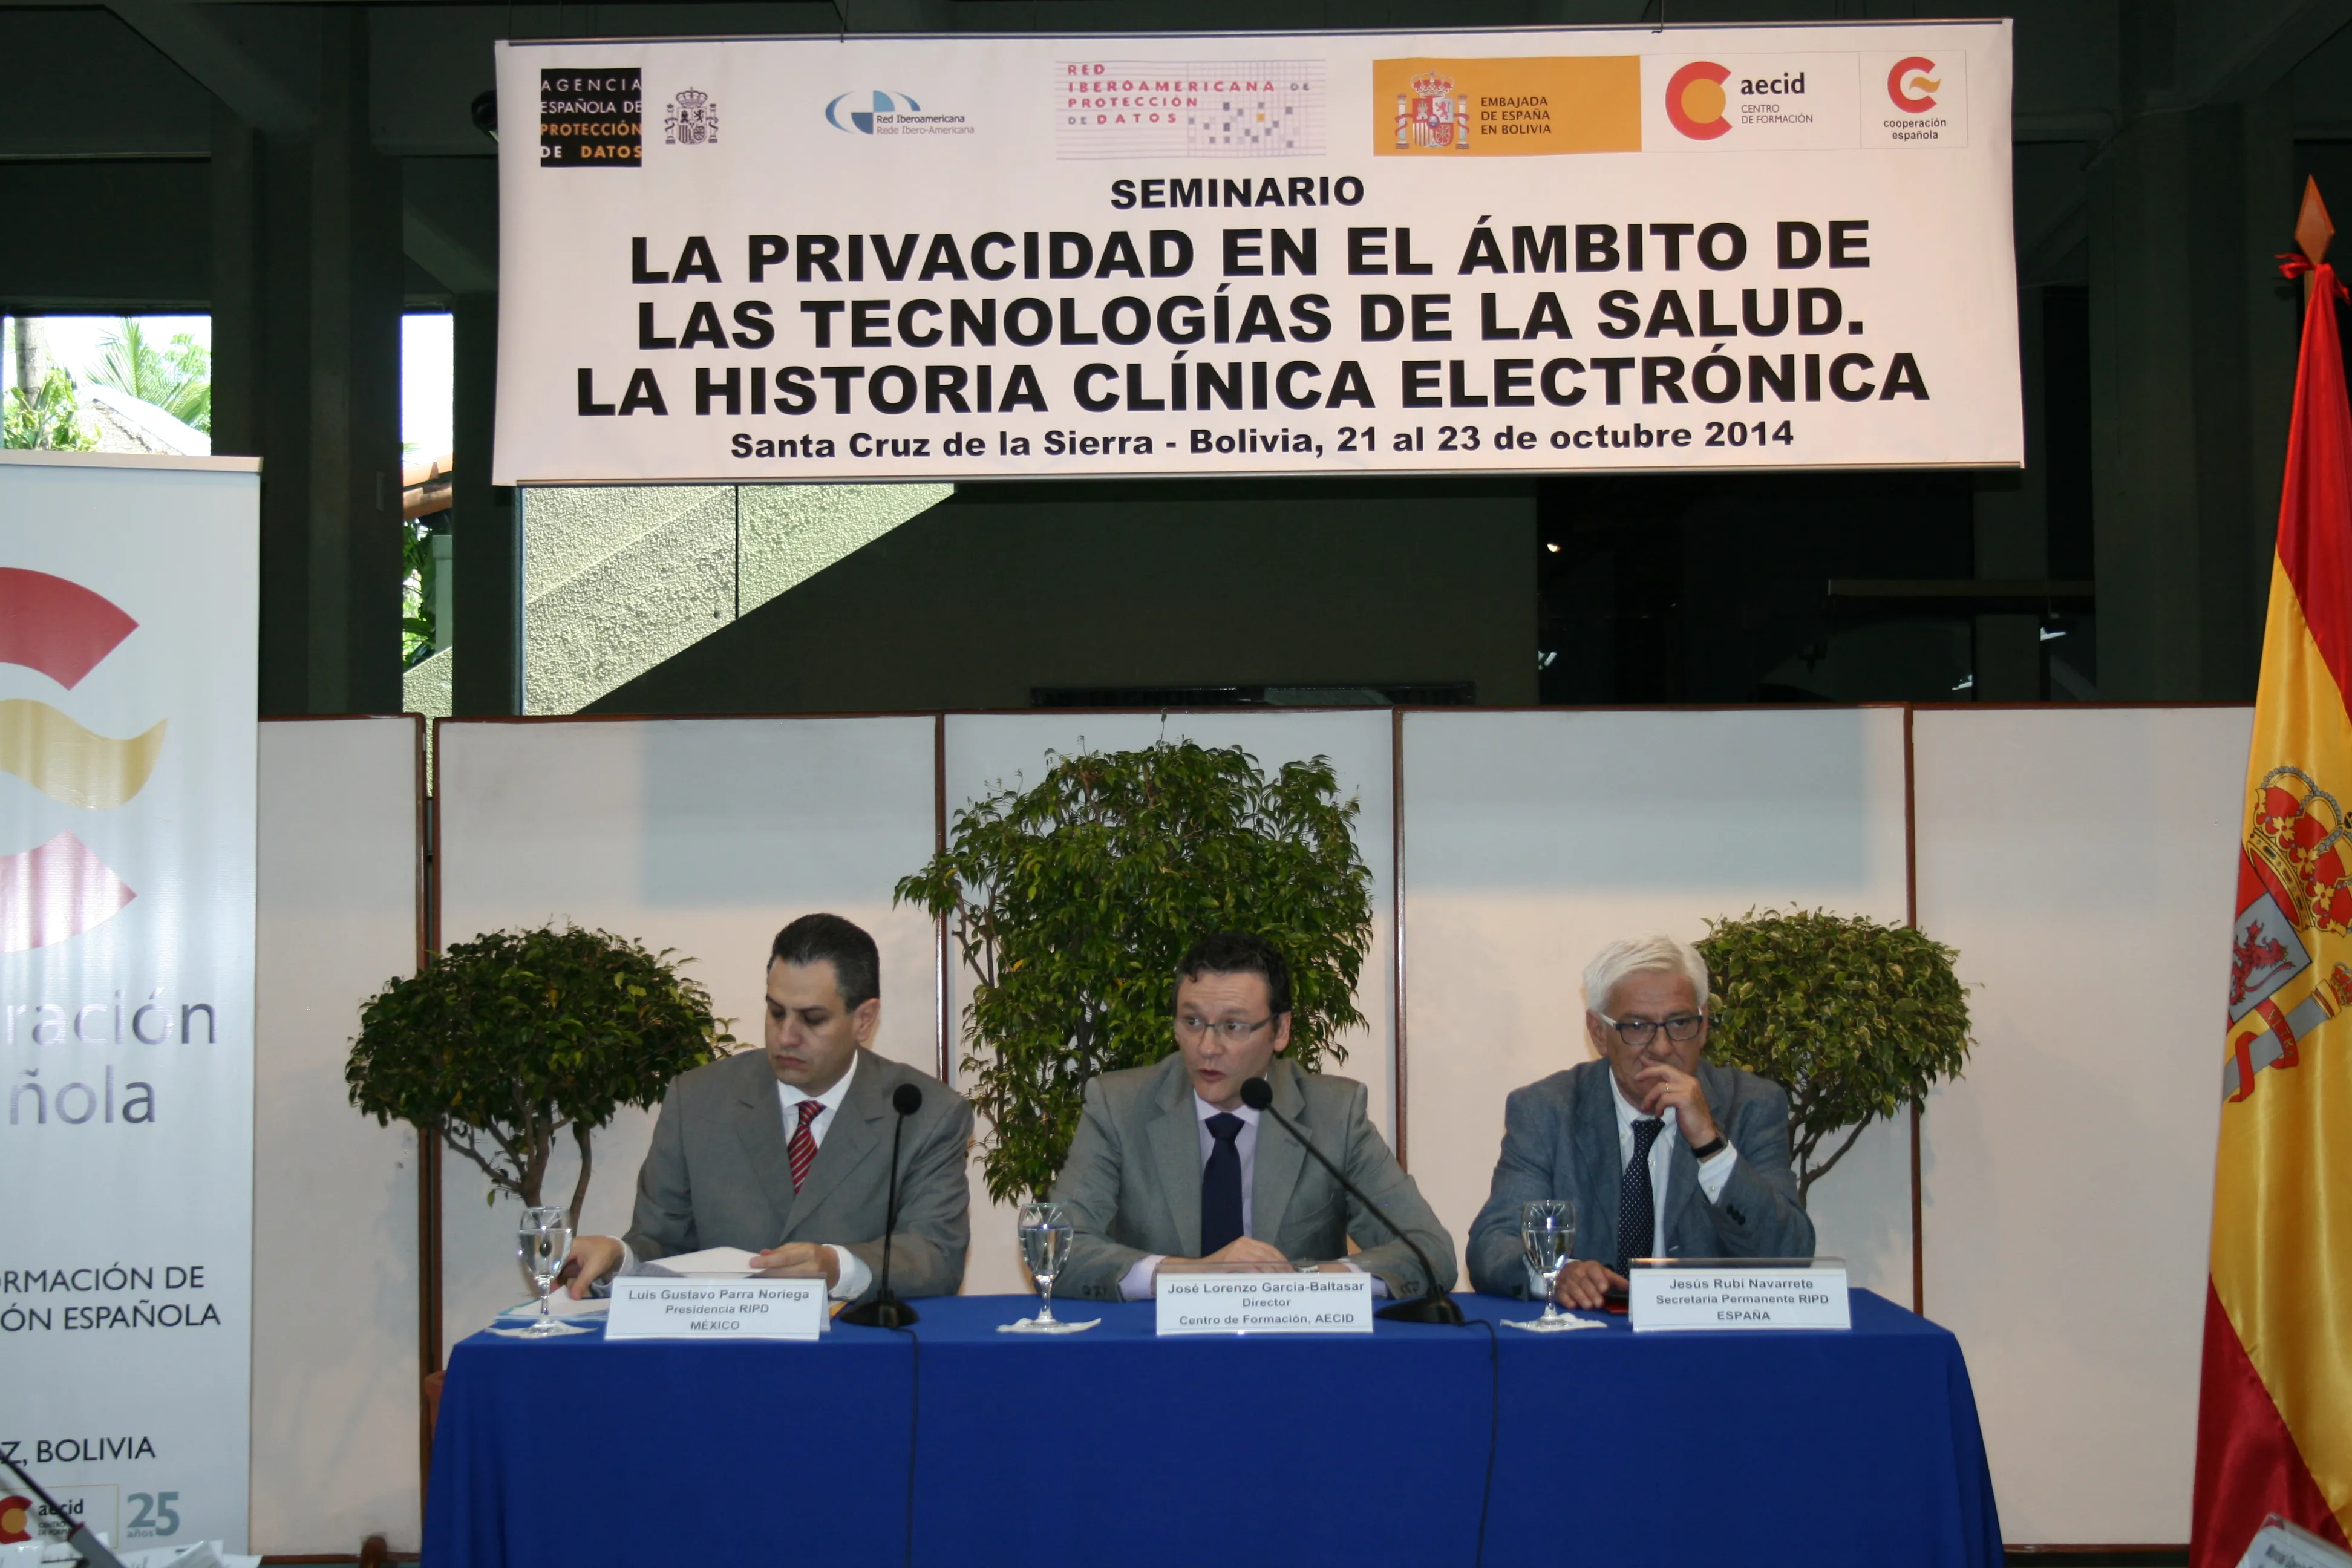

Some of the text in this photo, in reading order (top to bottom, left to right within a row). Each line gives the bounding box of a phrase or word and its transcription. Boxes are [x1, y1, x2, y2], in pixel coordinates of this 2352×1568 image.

[1068, 64, 1105, 76] RED
[541, 77, 642, 92] AGENCIA
[1068, 80, 1311, 93] IBEROAMERICANA DE
[1741, 72, 1804, 95] aecid
[541, 97, 642, 114] ESPAÑOLA DE
[1068, 96, 1198, 108] PROTECCIÓN
[1481, 96, 1548, 108] EMBAJADA
[1481, 106, 1550, 121] DE ESPAÑA
[1740, 104, 1780, 114] CENTRO
[875, 113, 966, 125] Red Iberoamericana
[1068, 113, 1177, 126] DE DATOS
[1741, 111, 1813, 124] DE FORMACIÓN
[1883, 117, 1947, 131] cooperación
[541, 120, 641, 136] PROTECCIÓN
[876, 125, 975, 136] Rede Ibero-Americana
[1481, 124, 1551, 135] EN BOLIVIA
[1892, 129, 1938, 142] española
[540, 145, 642, 159] DE DATOS
[1111, 177, 1364, 209] SEMINARIO
[632, 215, 1870, 284] LA PRIVACIDAD EN EL ÁMBITO DE
[639, 283, 1863, 350] LAS TECNOLOGÍAS DE LA SALUD.
[578, 343, 1930, 416] LA HISTORIA CLÍNICA ELECTRÓNICA
[731, 434, 835, 458] Santa
[849, 433, 930, 457] Cruz
[944, 432, 985, 456] de
[1000, 431, 1030, 456] la
[1044, 430, 1152, 455] Sierra
[1191, 428, 1322, 458] Bolivia,
[1338, 426, 1374, 451] 21
[1393, 427, 1423, 451] al
[1438, 426, 1480, 451] 23
[1494, 426, 1537, 450] de
[1551, 423, 1691, 449] octubre
[1705, 420, 1793, 446] 2014
[0, 1262, 203, 1293] RMACIÓN DE
[1670, 1278, 1813, 1289] Jesús Rubí Navarrete
[1168, 1283, 1199, 1294] José
[1204, 1283, 1258, 1293] Lorenzo
[661, 1289, 717, 1299] Gustavo
[719, 1289, 754, 1299] Parra
[759, 1289, 809, 1302] Noriega
[1722, 1294, 1795, 1304] Permanente
[1797, 1295, 1829, 1304] RIPD
[665, 1304, 771, 1314] Presidencia RIPD
[1243, 1298, 1291, 1307] Director
[1, 1300, 221, 1331] ÓN ESPAÑOLA
[1179, 1313, 1354, 1325] Centro de Formación, AECID
[1717, 1309, 1771, 1321] ESPAÑA
[690, 1319, 741, 1330] MÉXICO
[37, 1437, 155, 1462] BOLIVIA
[127, 1491, 180, 1536] 25
[126, 1527, 155, 1538] años
